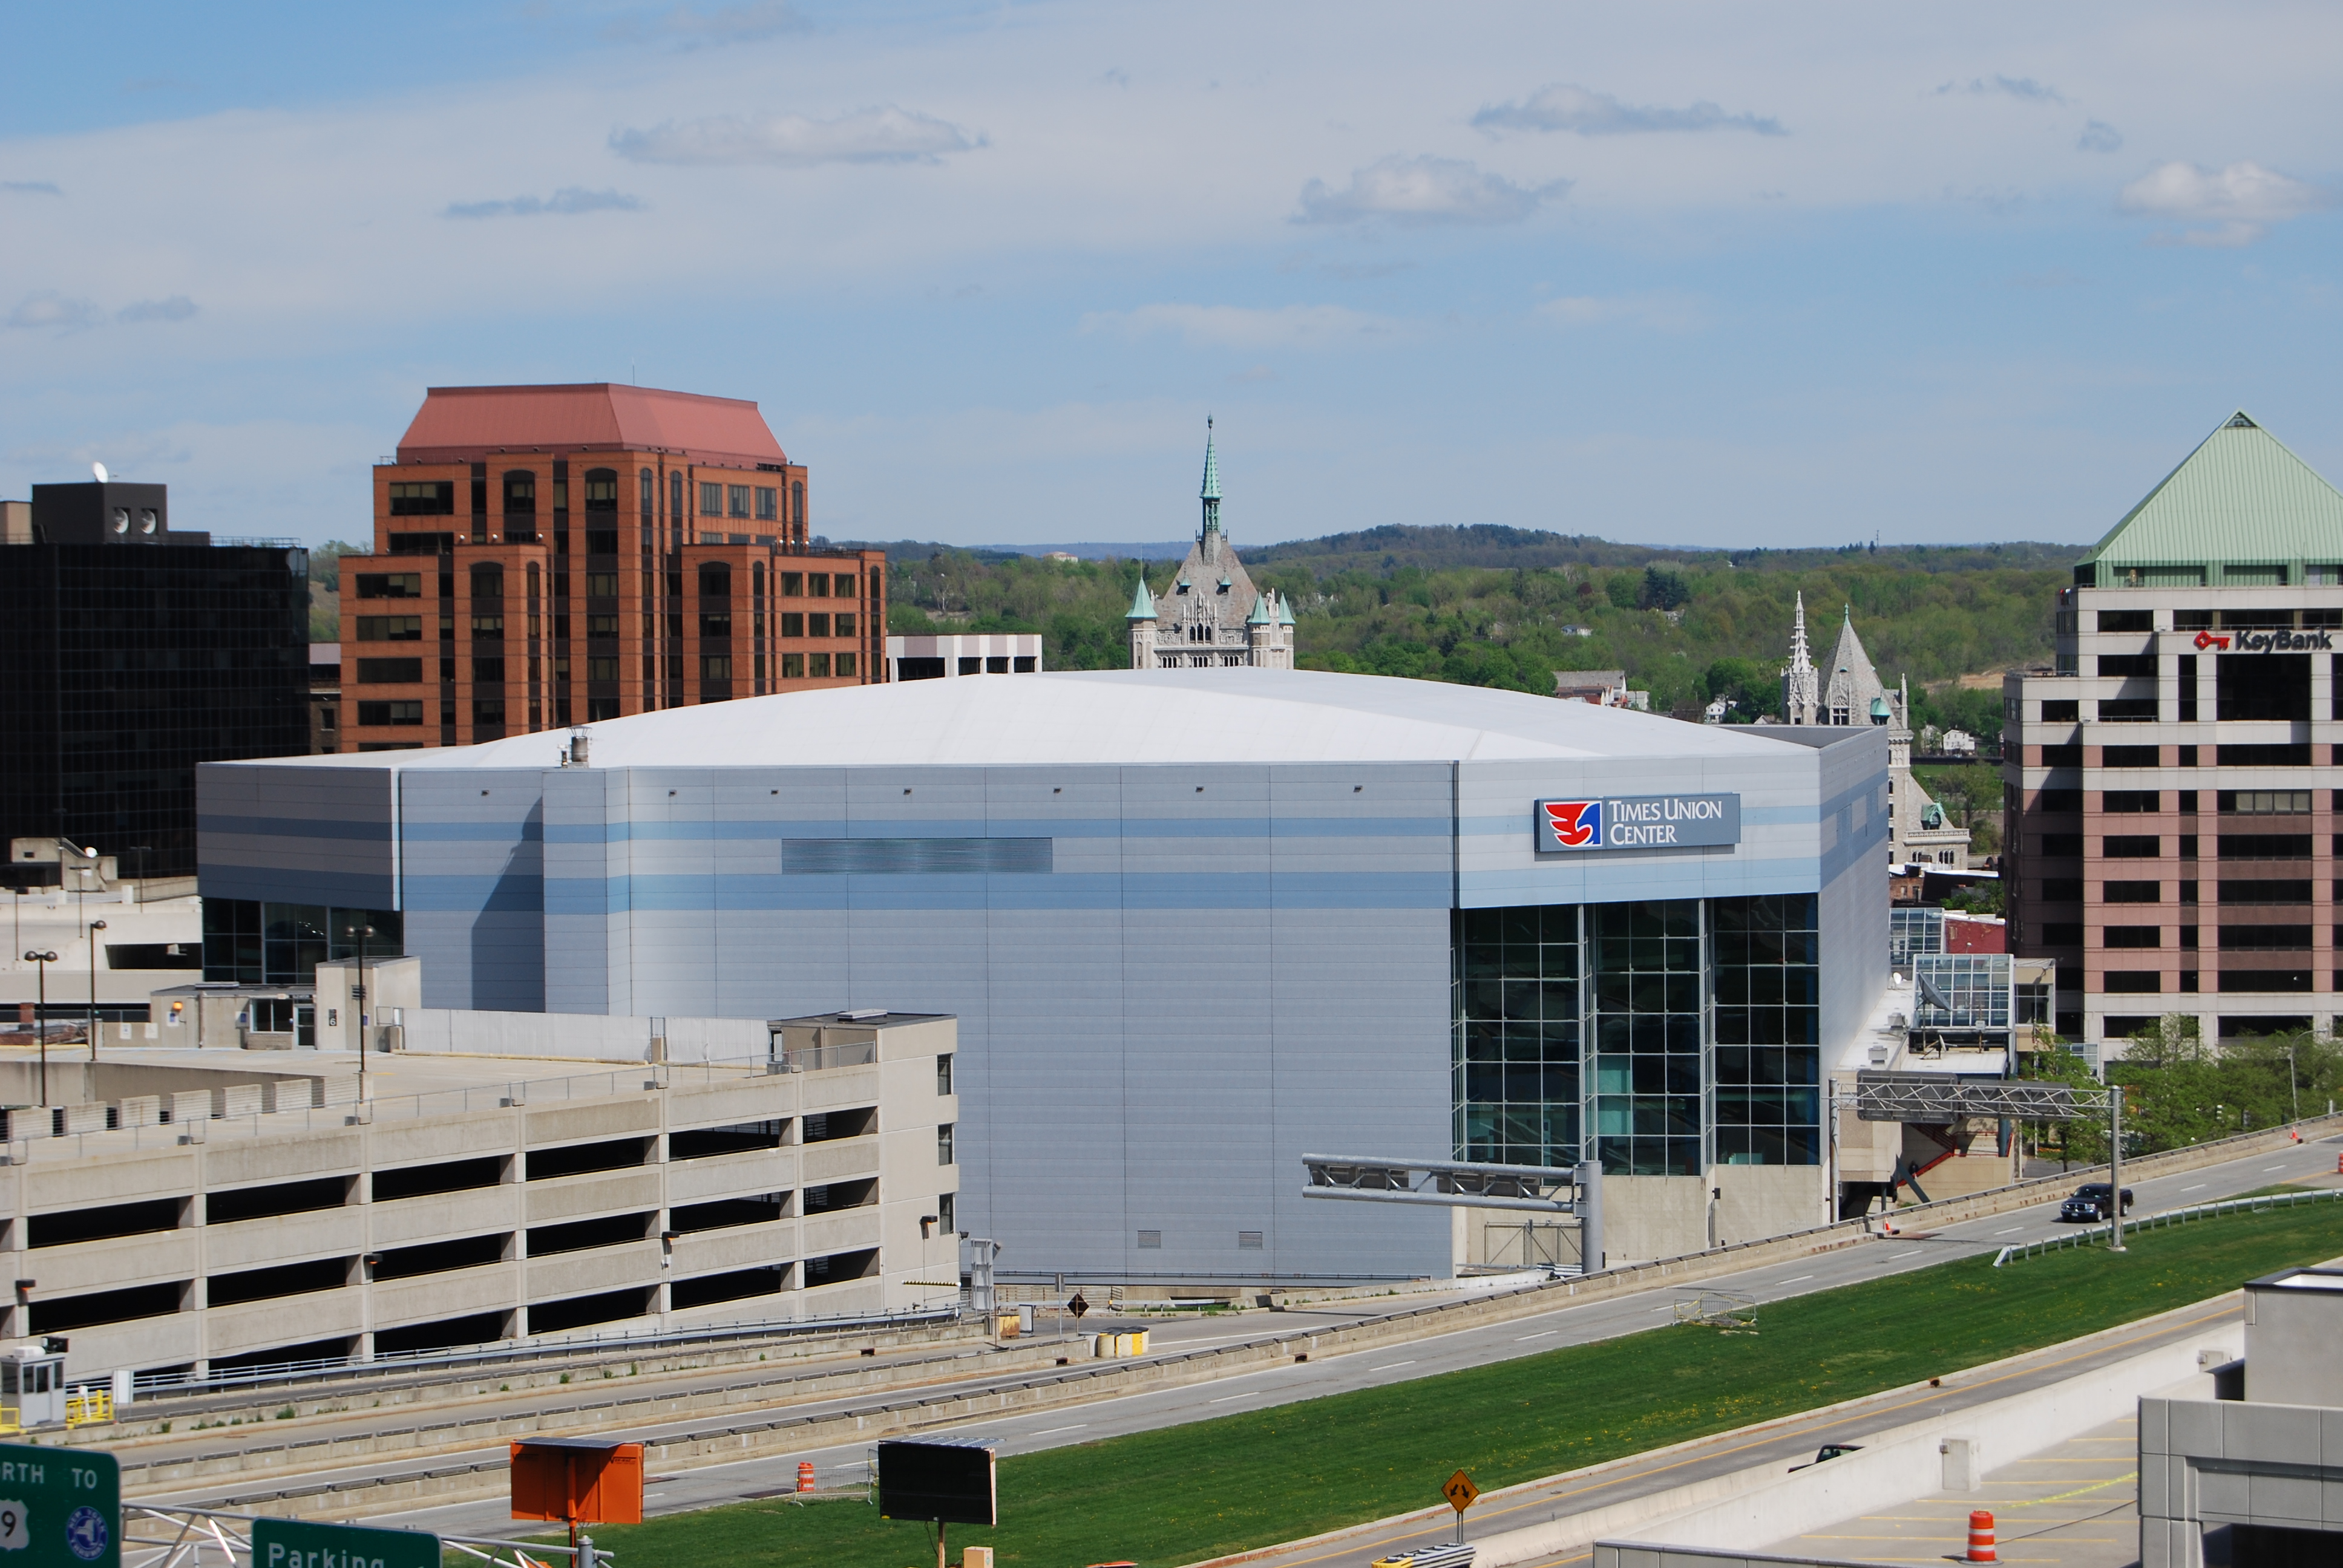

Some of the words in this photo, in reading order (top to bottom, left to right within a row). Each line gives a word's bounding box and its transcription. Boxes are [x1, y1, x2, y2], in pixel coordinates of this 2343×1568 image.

[2235, 629, 2333, 654] KeyBank
[1608, 800, 1660, 822] TIMES
[1664, 799, 1723, 821] UNION
[1610, 823, 1678, 846] CENTER
[0, 1461, 45, 1484] RTH
[71, 1468, 97, 1489] TO
[2, 1510, 16, 1537] 9
